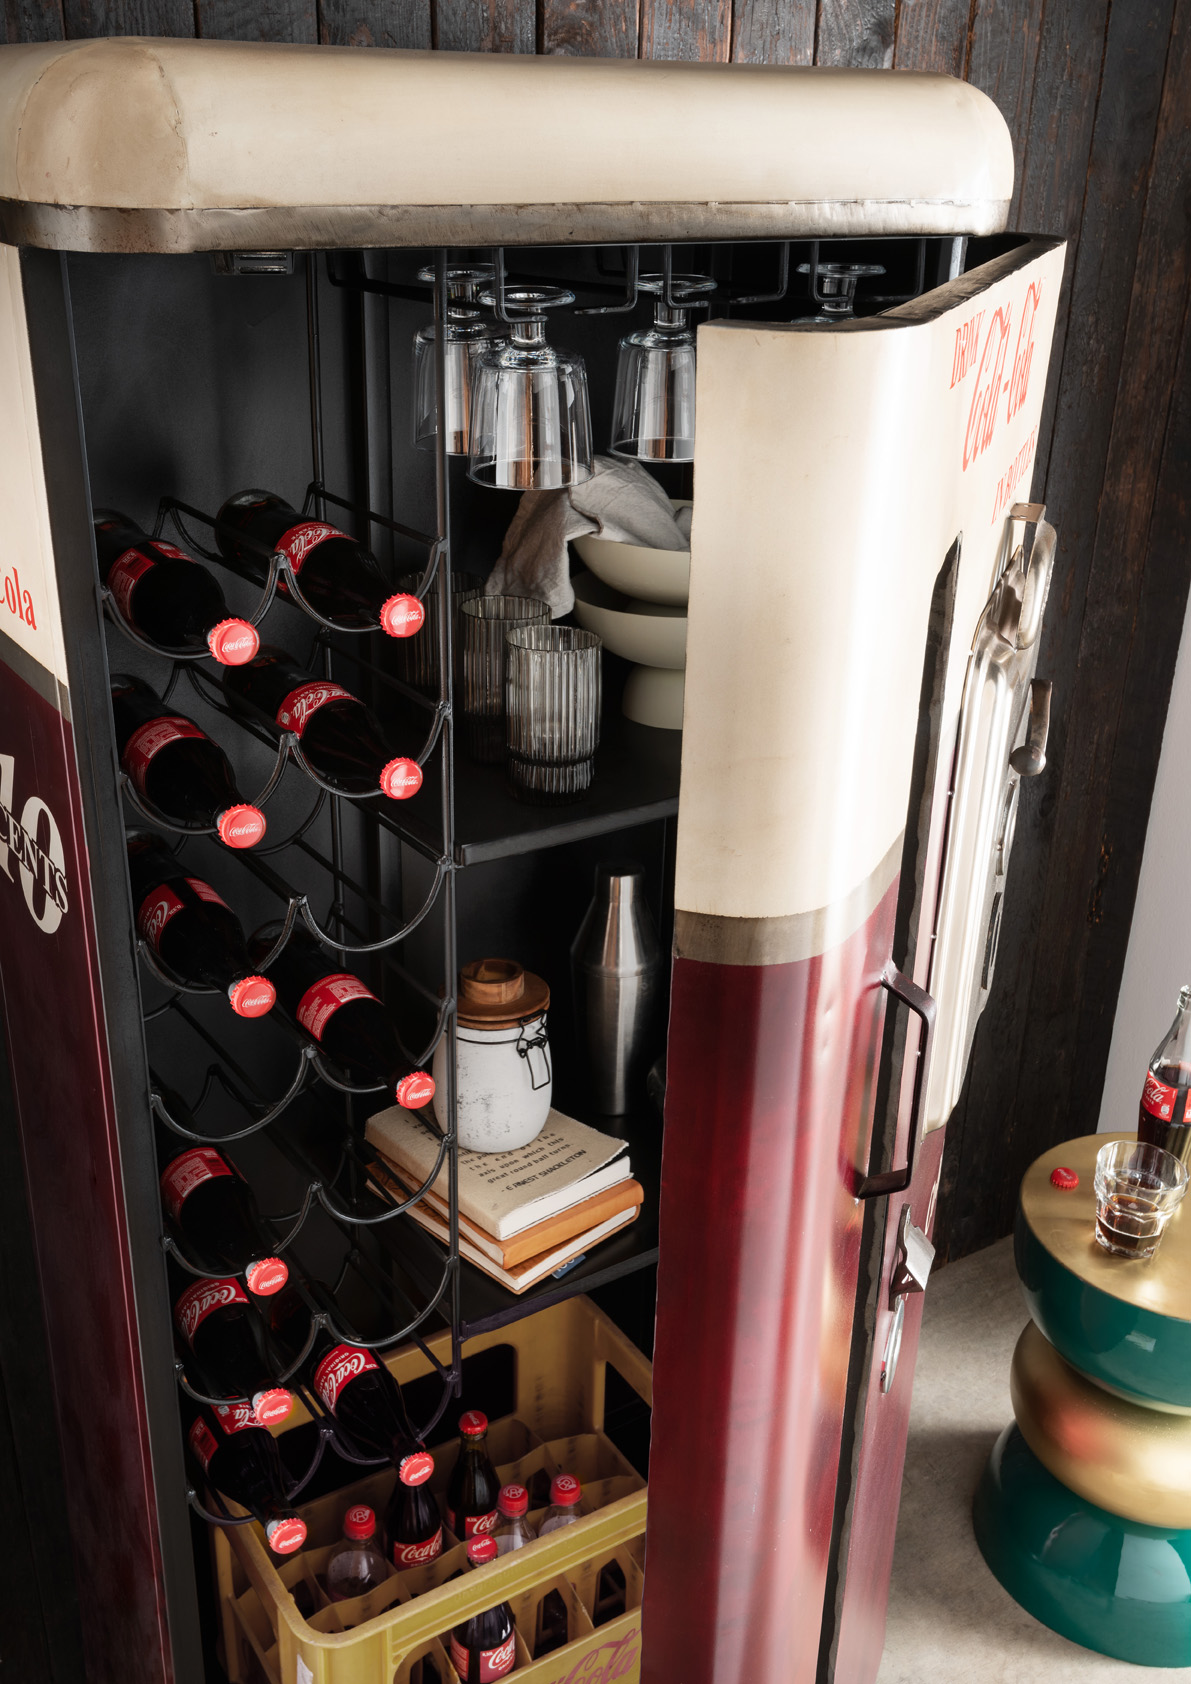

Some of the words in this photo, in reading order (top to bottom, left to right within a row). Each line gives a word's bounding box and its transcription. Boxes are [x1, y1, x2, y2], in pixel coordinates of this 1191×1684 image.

[962, 277, 1045, 472] Coca-Cola
[0, 566, 37, 631] ola
[487, 1172, 509, 1183] great
[510, 1161, 533, 1174] round
[532, 1153, 549, 1164] ball
[499, 1159, 519, 1169] upon
[522, 1146, 545, 1159] which
[547, 1137, 564, 1147] this
[538, 1149, 587, 1178] SHACKLETON
